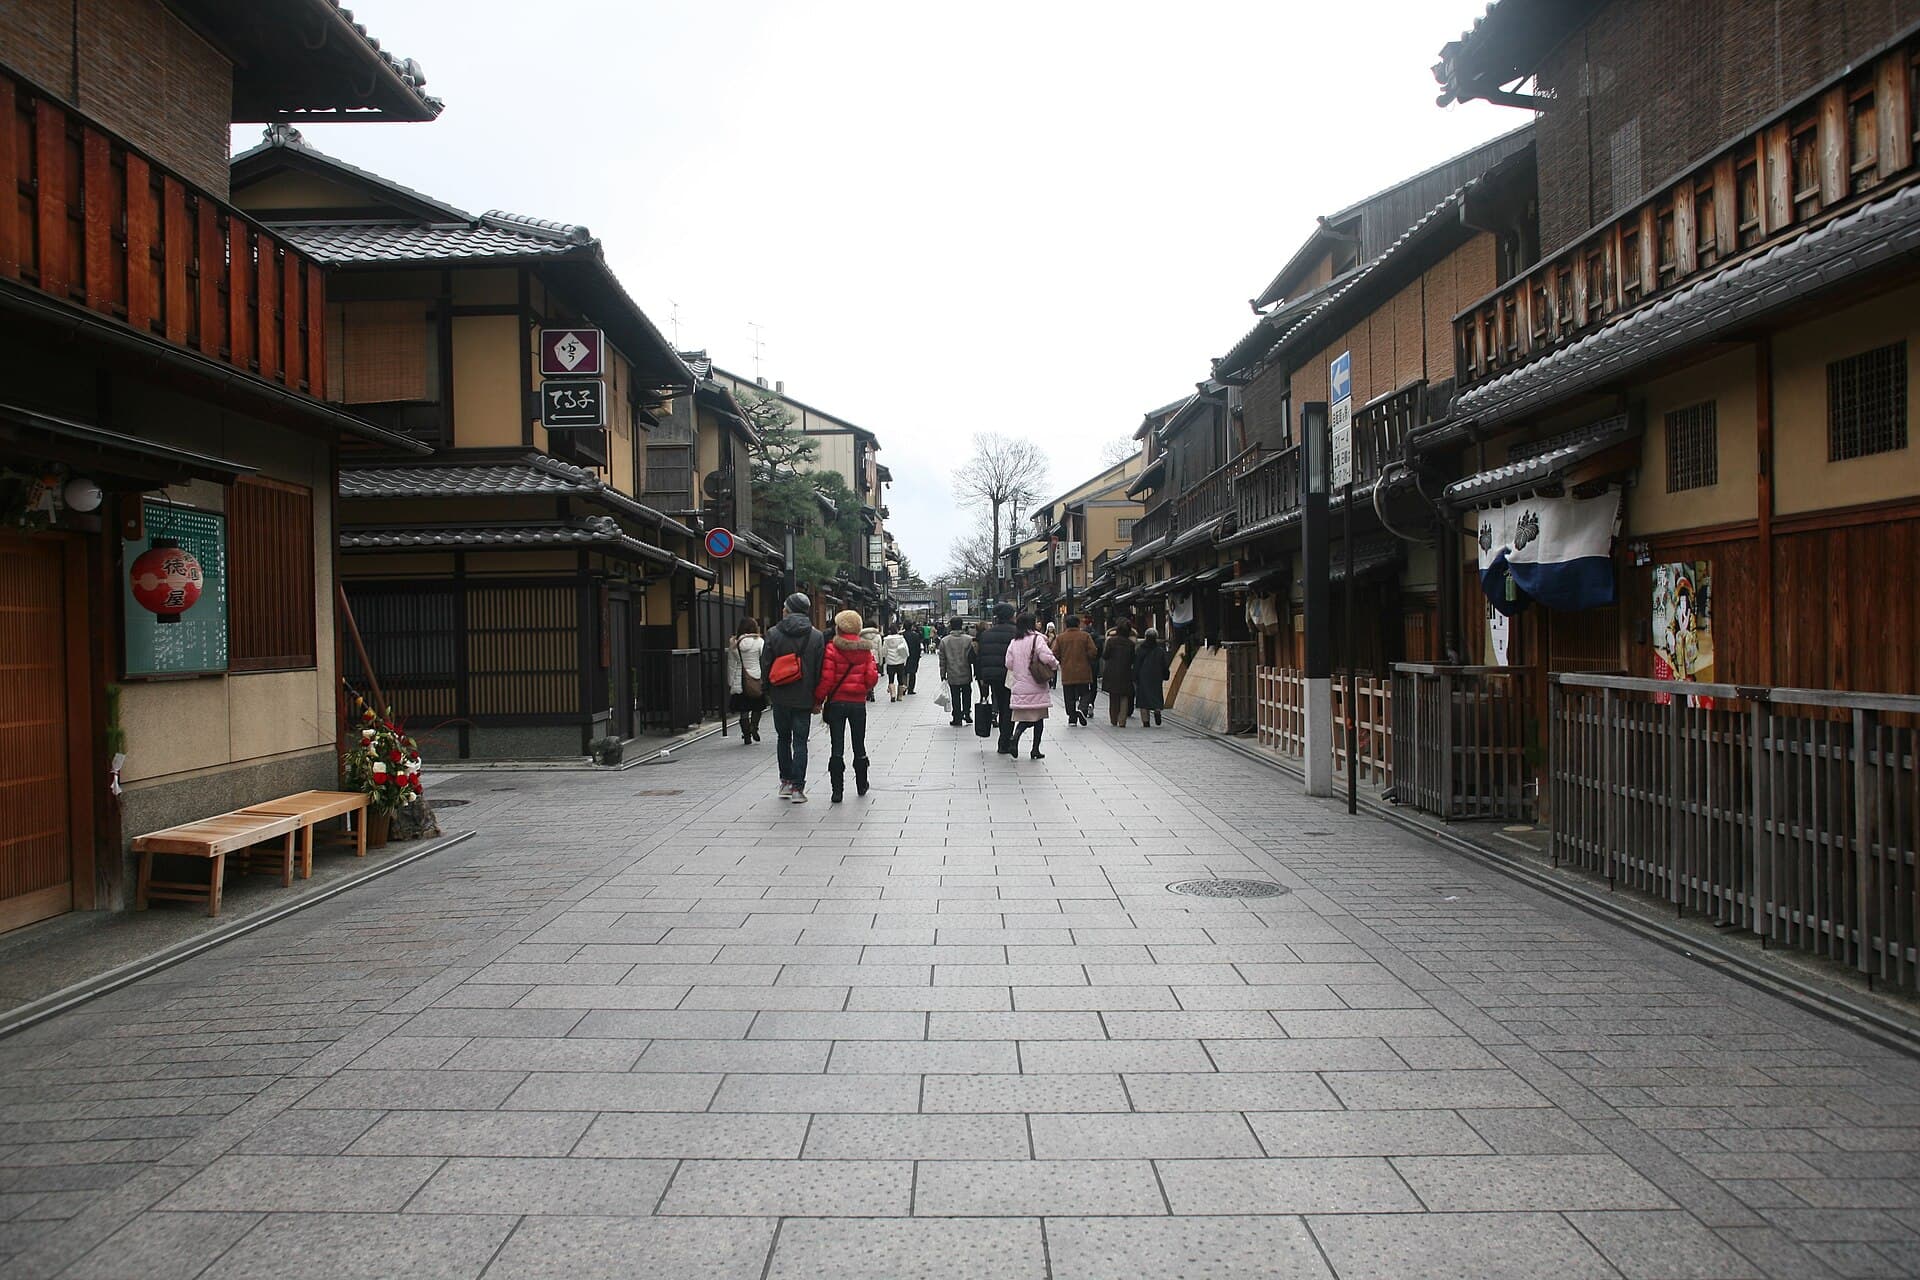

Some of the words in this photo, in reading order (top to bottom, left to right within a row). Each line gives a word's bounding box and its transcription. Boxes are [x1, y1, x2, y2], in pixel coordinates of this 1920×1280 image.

[549, 390, 595, 409] てる子
[163, 558, 187, 607] 徳屋
